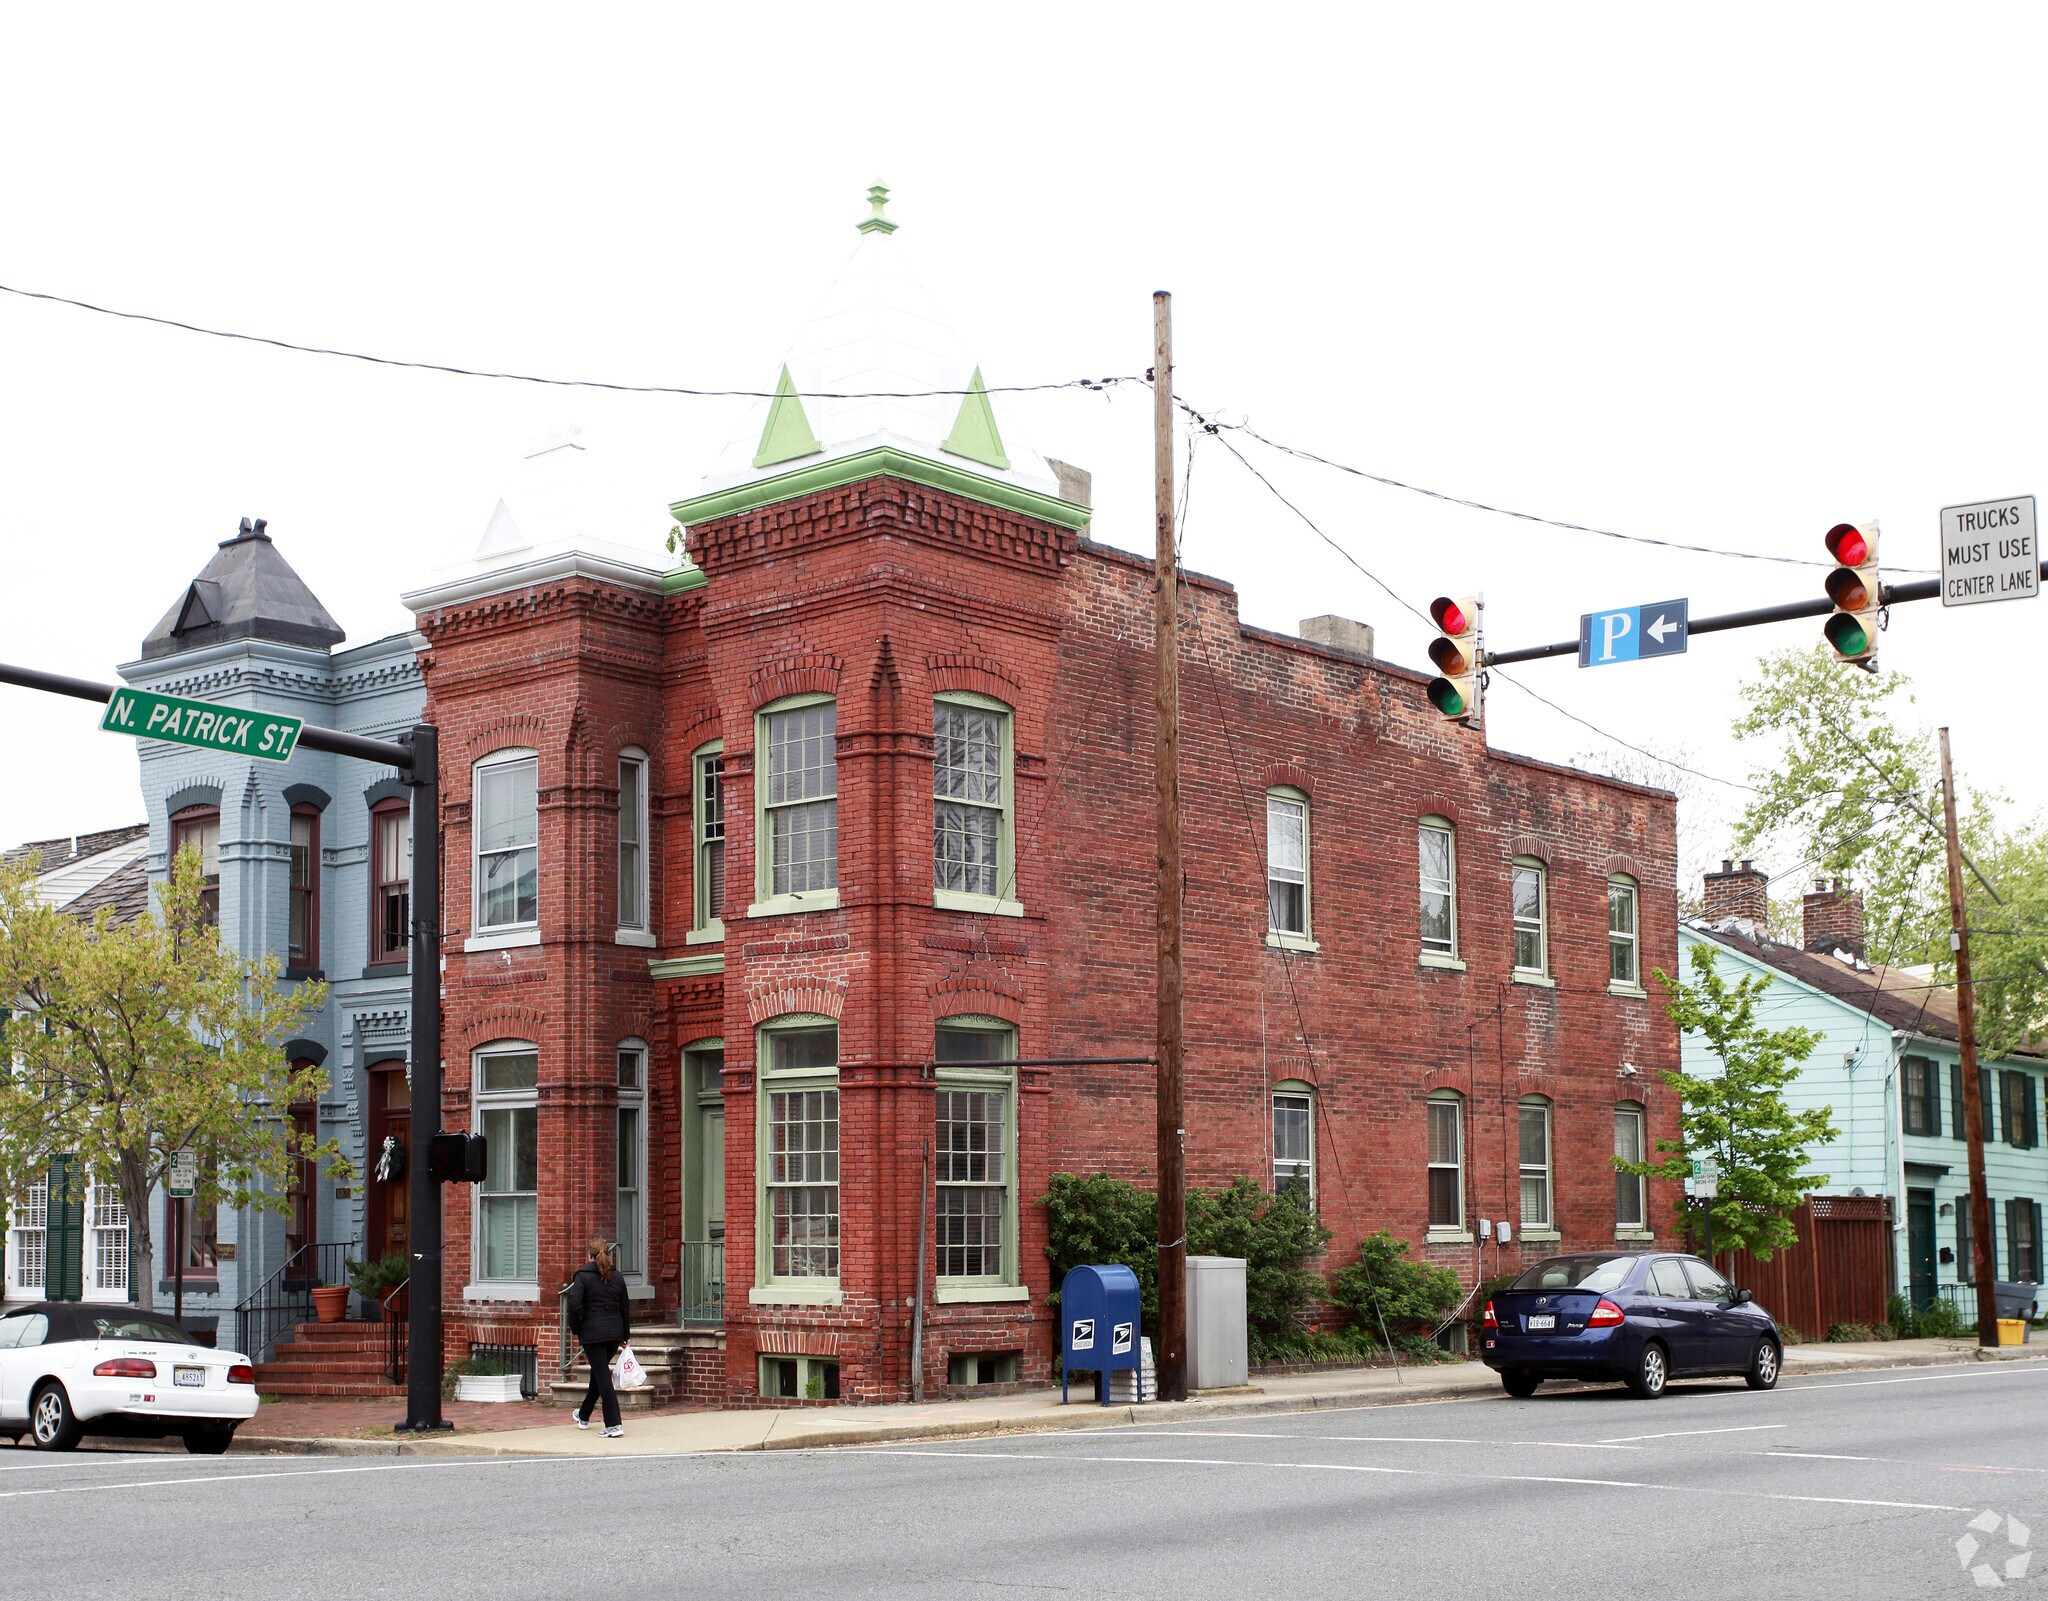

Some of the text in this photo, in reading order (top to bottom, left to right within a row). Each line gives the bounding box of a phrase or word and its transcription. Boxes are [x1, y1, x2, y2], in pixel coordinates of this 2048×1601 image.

[1956, 506, 2020, 533] TRUCKS
[1948, 537, 2031, 566] MUST USE
[1948, 570, 2033, 598] CENTER LANE
[1598, 612, 1632, 661] P
[110, 696, 295, 755] N. PATRICK ST.
[172, 1155, 177, 1166] 2
[1694, 1163, 1700, 1173] 2
